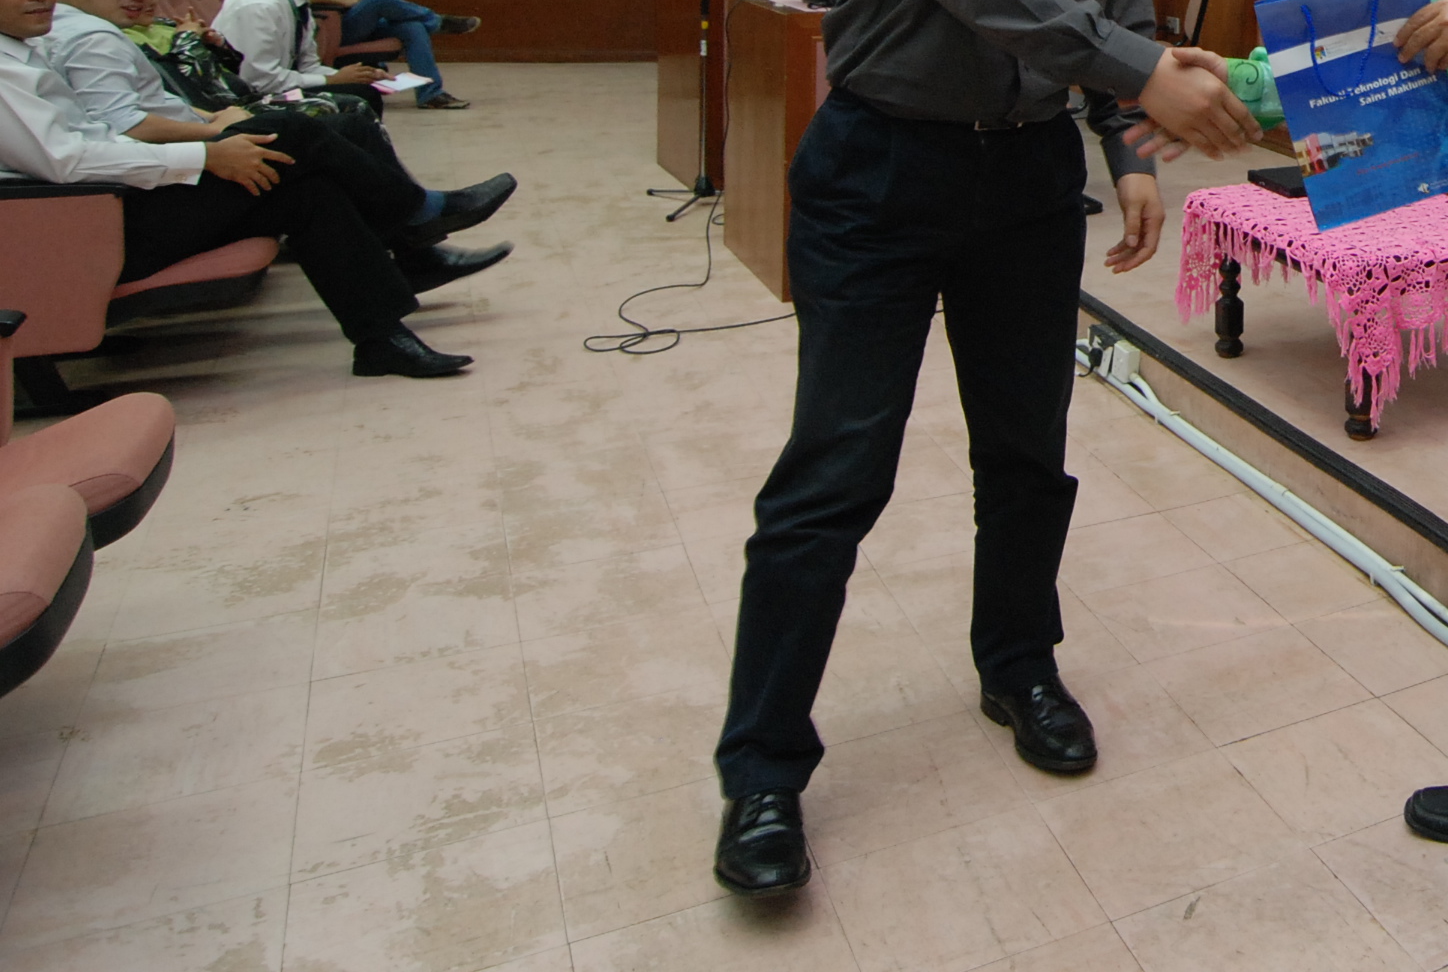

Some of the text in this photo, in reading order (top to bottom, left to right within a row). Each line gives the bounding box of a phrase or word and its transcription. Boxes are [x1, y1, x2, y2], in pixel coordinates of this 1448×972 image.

[1400, 67, 1422, 80] Dan
[1359, 74, 1438, 107] Sains Maklumat
